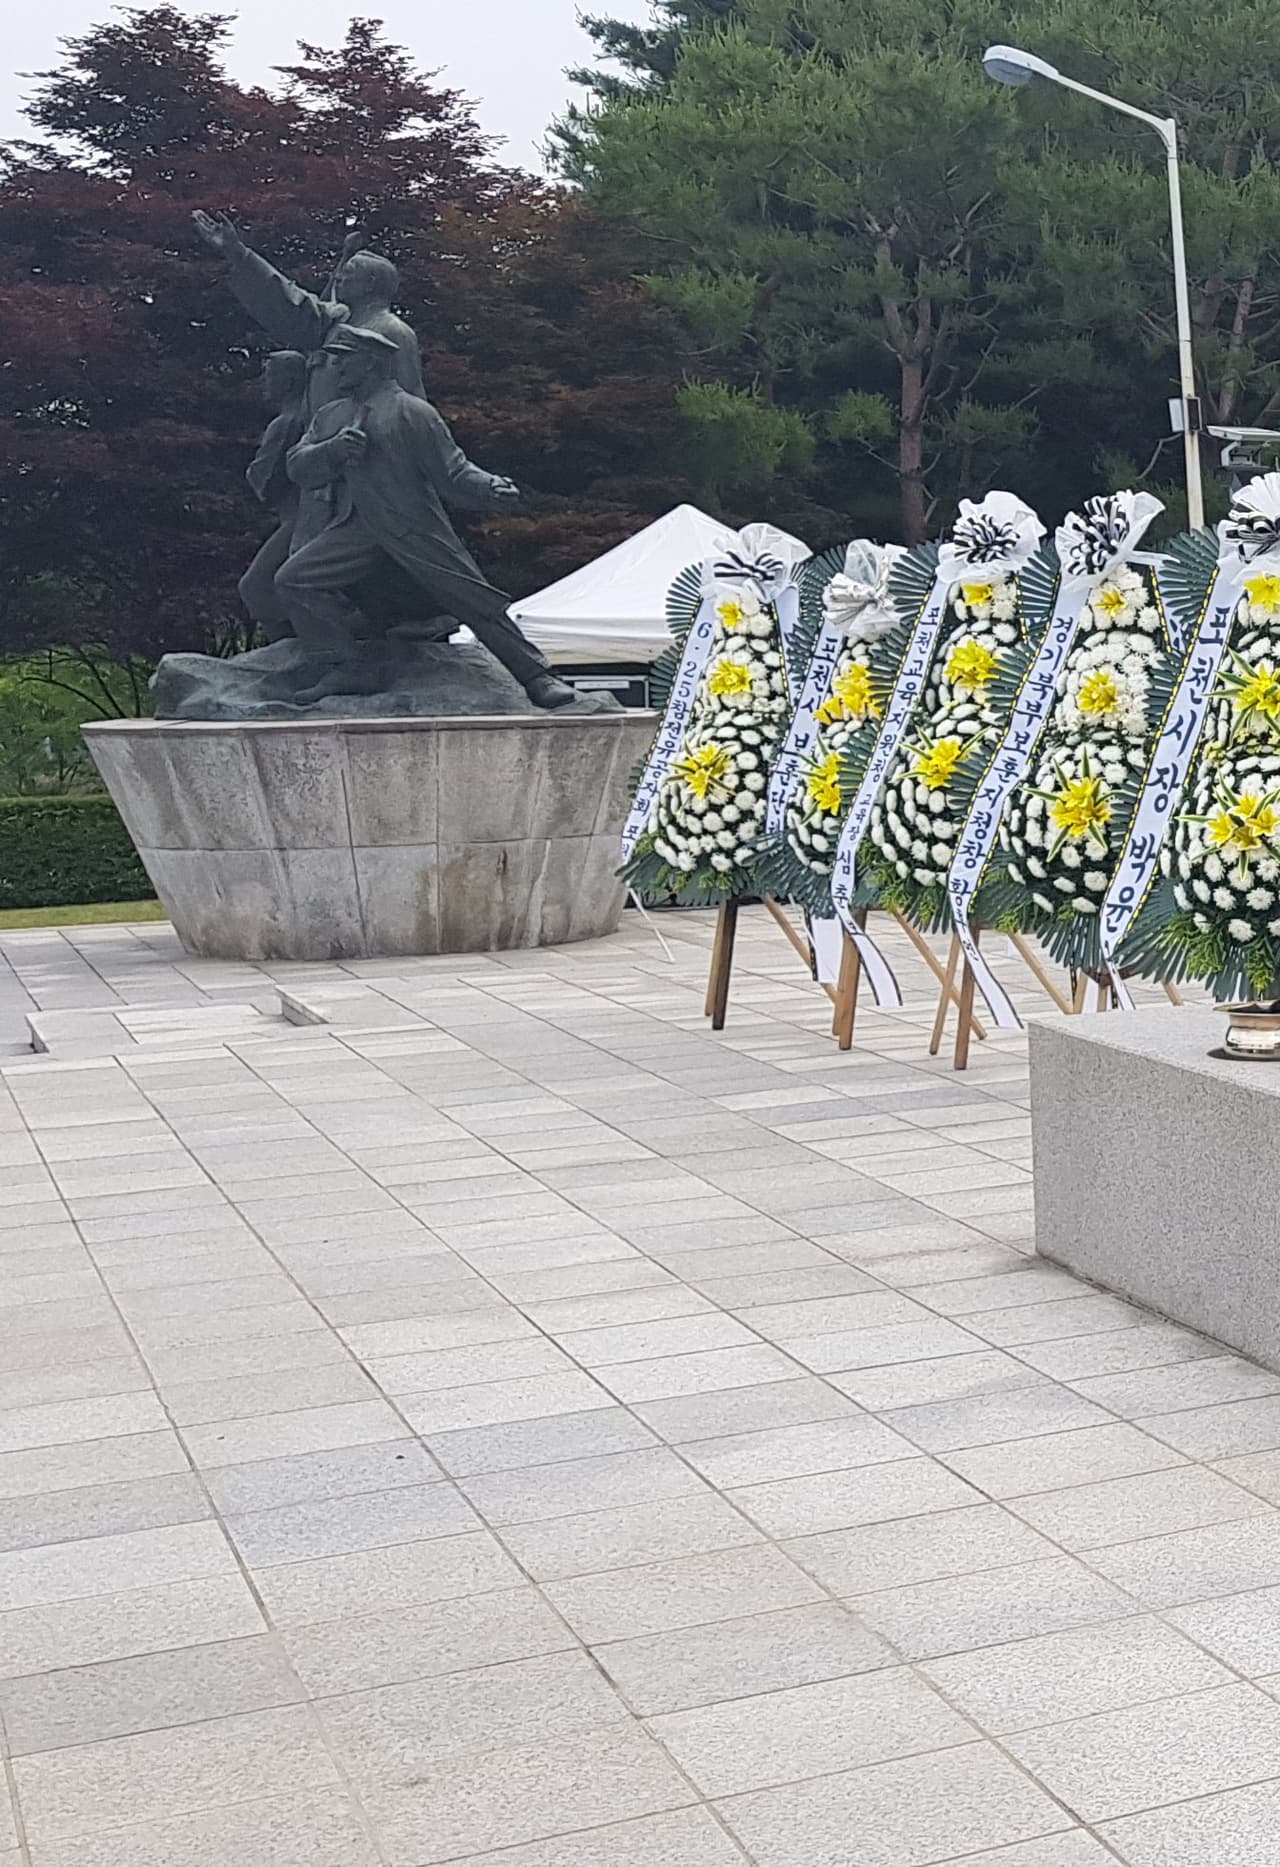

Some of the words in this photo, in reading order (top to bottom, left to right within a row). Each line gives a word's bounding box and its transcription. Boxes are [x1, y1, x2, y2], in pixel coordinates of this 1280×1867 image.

[959, 616, 1074, 869] 경기북부보훈지청장
[1147, 606, 1231, 814] 포천시장
[1104, 832, 1157, 974] 박윤
